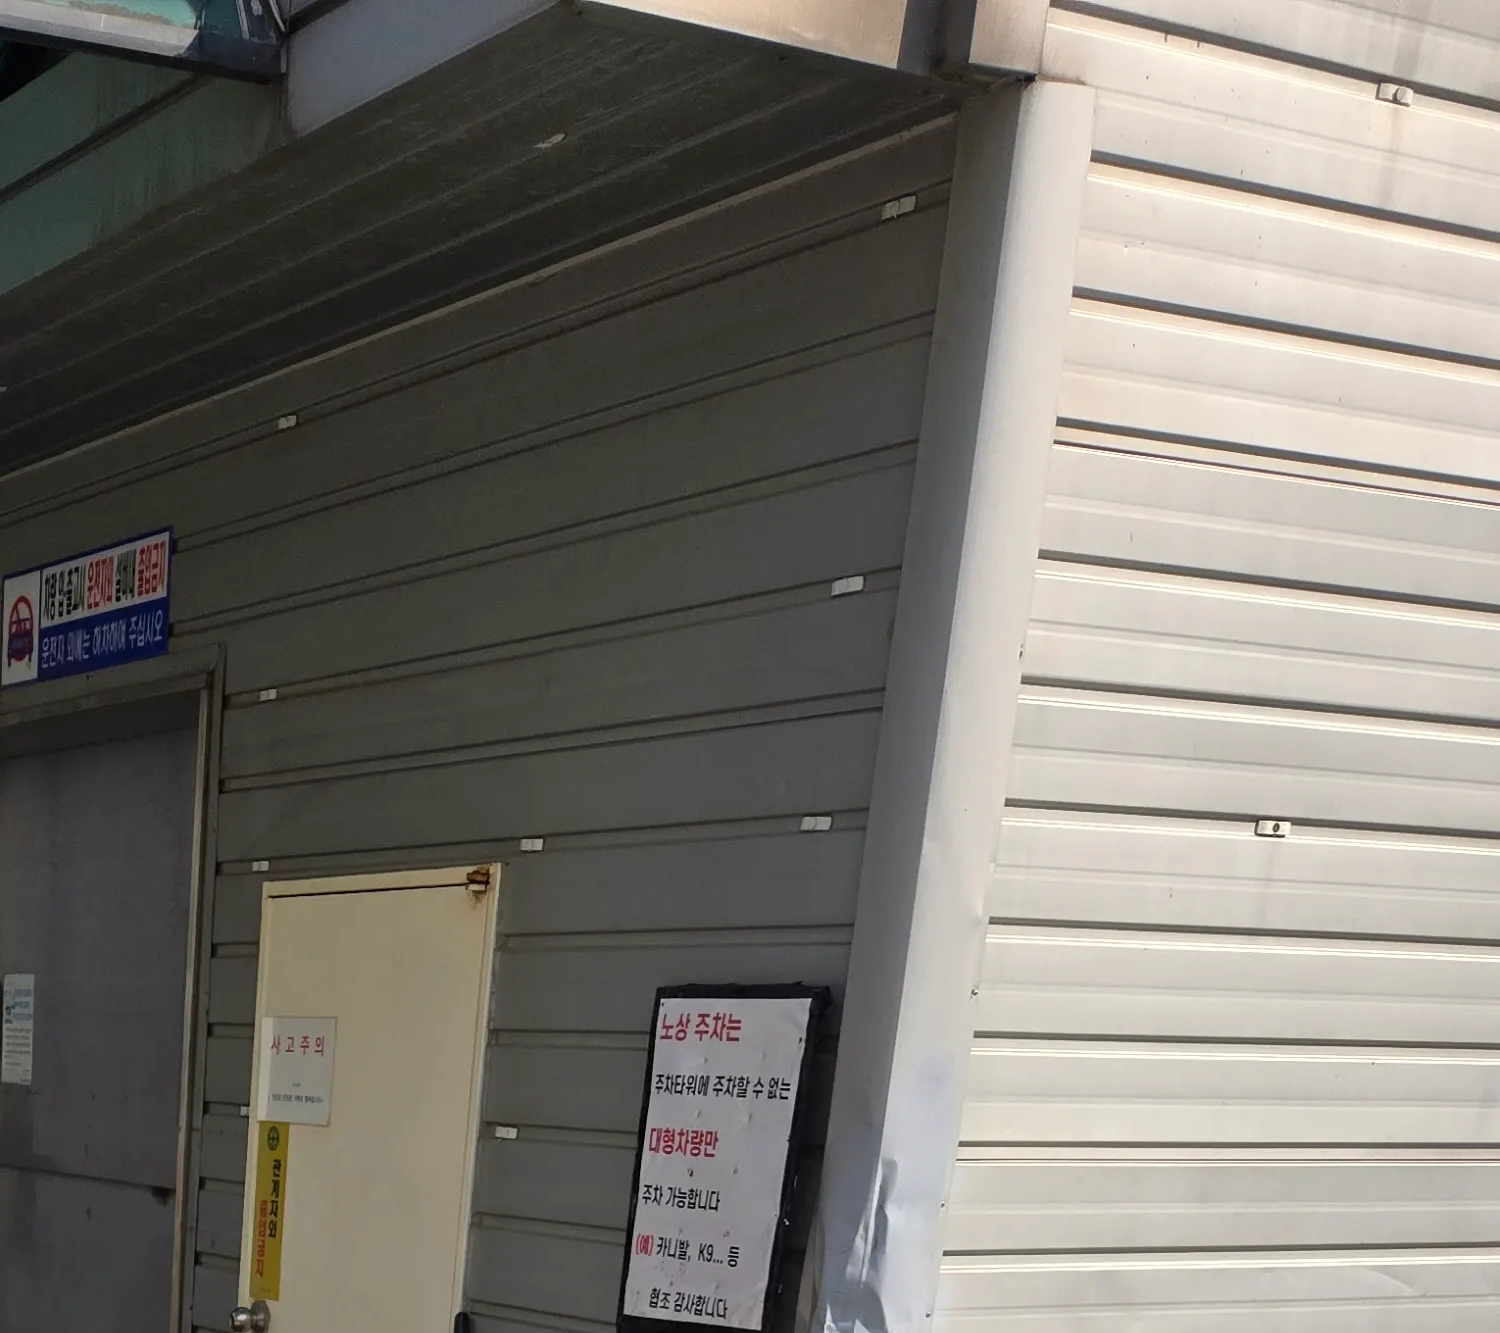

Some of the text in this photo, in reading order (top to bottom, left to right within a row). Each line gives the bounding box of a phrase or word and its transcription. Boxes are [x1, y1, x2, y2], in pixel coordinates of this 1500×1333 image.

[128, 609, 163, 648] 주십시오
[660, 1012, 742, 1043] 노상 주차는
[655, 1074, 791, 1101] 주차타워에 주차할 수 없는
[649, 1127, 719, 1159] 대형차량만
[642, 1183, 721, 1213] 주차 가능합니다
[635, 1232, 654, 1258] (예)
[655, 1236, 691, 1263] 카니발,
[727, 1245, 740, 1268] 등
[649, 1287, 728, 1321] 협조 감사합니다
